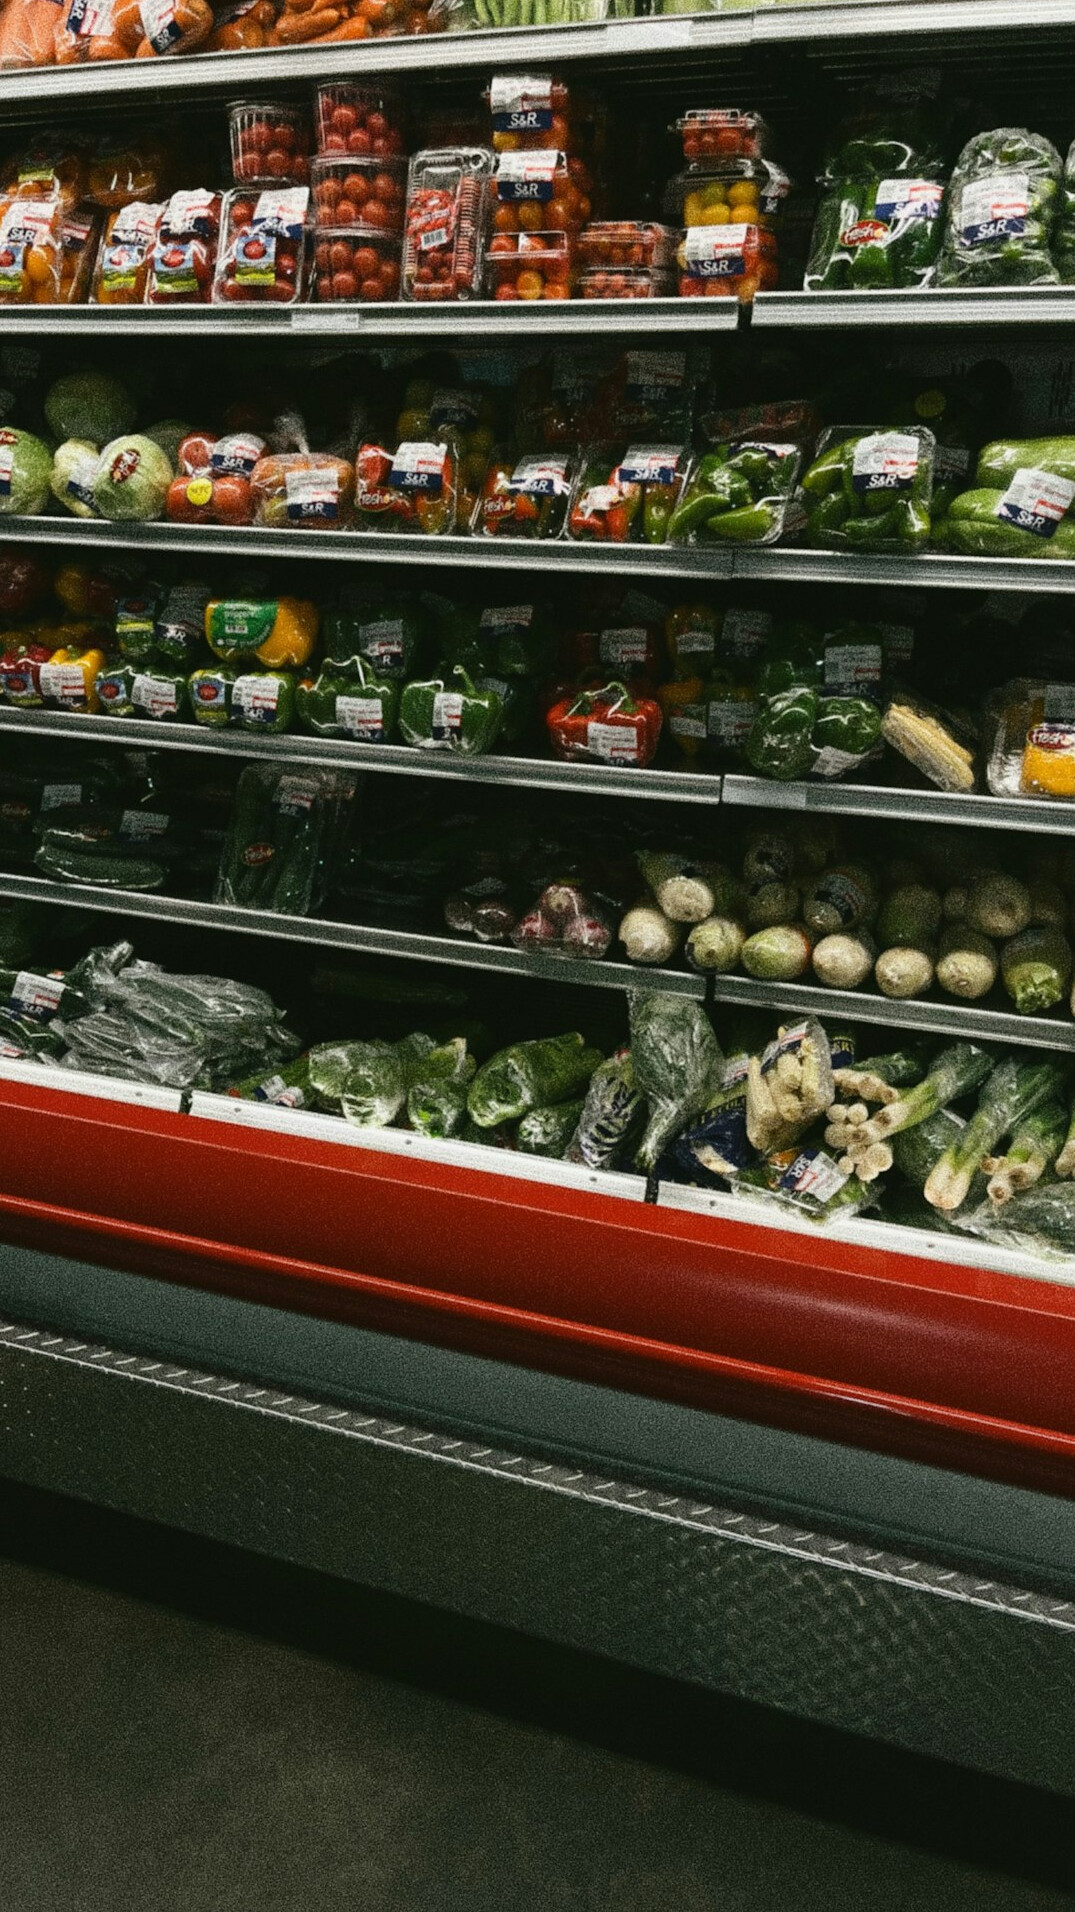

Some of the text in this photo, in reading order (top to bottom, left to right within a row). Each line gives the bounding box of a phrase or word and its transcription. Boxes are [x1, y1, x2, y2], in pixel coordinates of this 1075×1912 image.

[510, 112, 538, 126] S&R
[514, 183, 538, 196] S&R
[978, 219, 1007, 238] S&R
[703, 260, 729, 272] S&R
[221, 456, 244, 468] S&R
[405, 472, 428, 482] S&R
[869, 475, 897, 487] S&R
[301, 503, 324, 514] S&R
[1017, 510, 1046, 527] S&R
